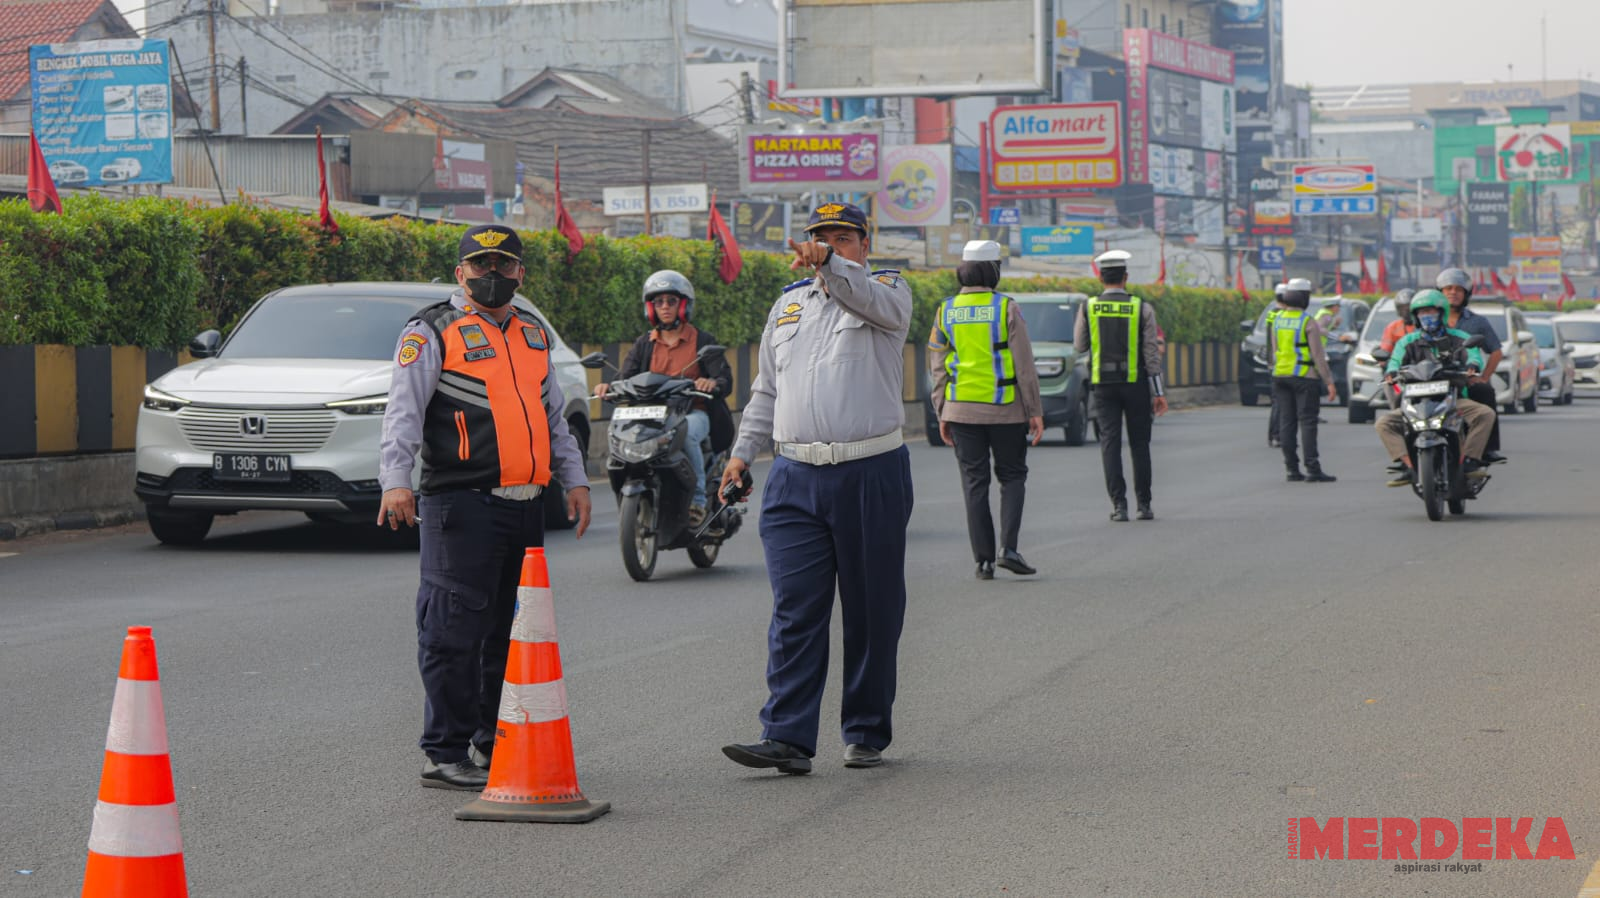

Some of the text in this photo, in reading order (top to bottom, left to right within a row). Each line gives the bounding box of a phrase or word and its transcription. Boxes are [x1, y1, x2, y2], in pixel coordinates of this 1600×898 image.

[37, 57, 78, 71] BENGKEL
[80, 55, 107, 68] MOBIL
[138, 52, 162, 65] JAYA
[1004, 114, 1107, 135] Alfamart
[754, 137, 843, 152] MARTABAK
[754, 154, 798, 167] PIZZA
[800, 153, 844, 167] ORINS
[611, 196, 700, 210] SURA BSD
[947, 306, 995, 322] POLISI
[1093, 303, 1134, 315] POLISI
[215, 455, 288, 471] B 1306 CYN
